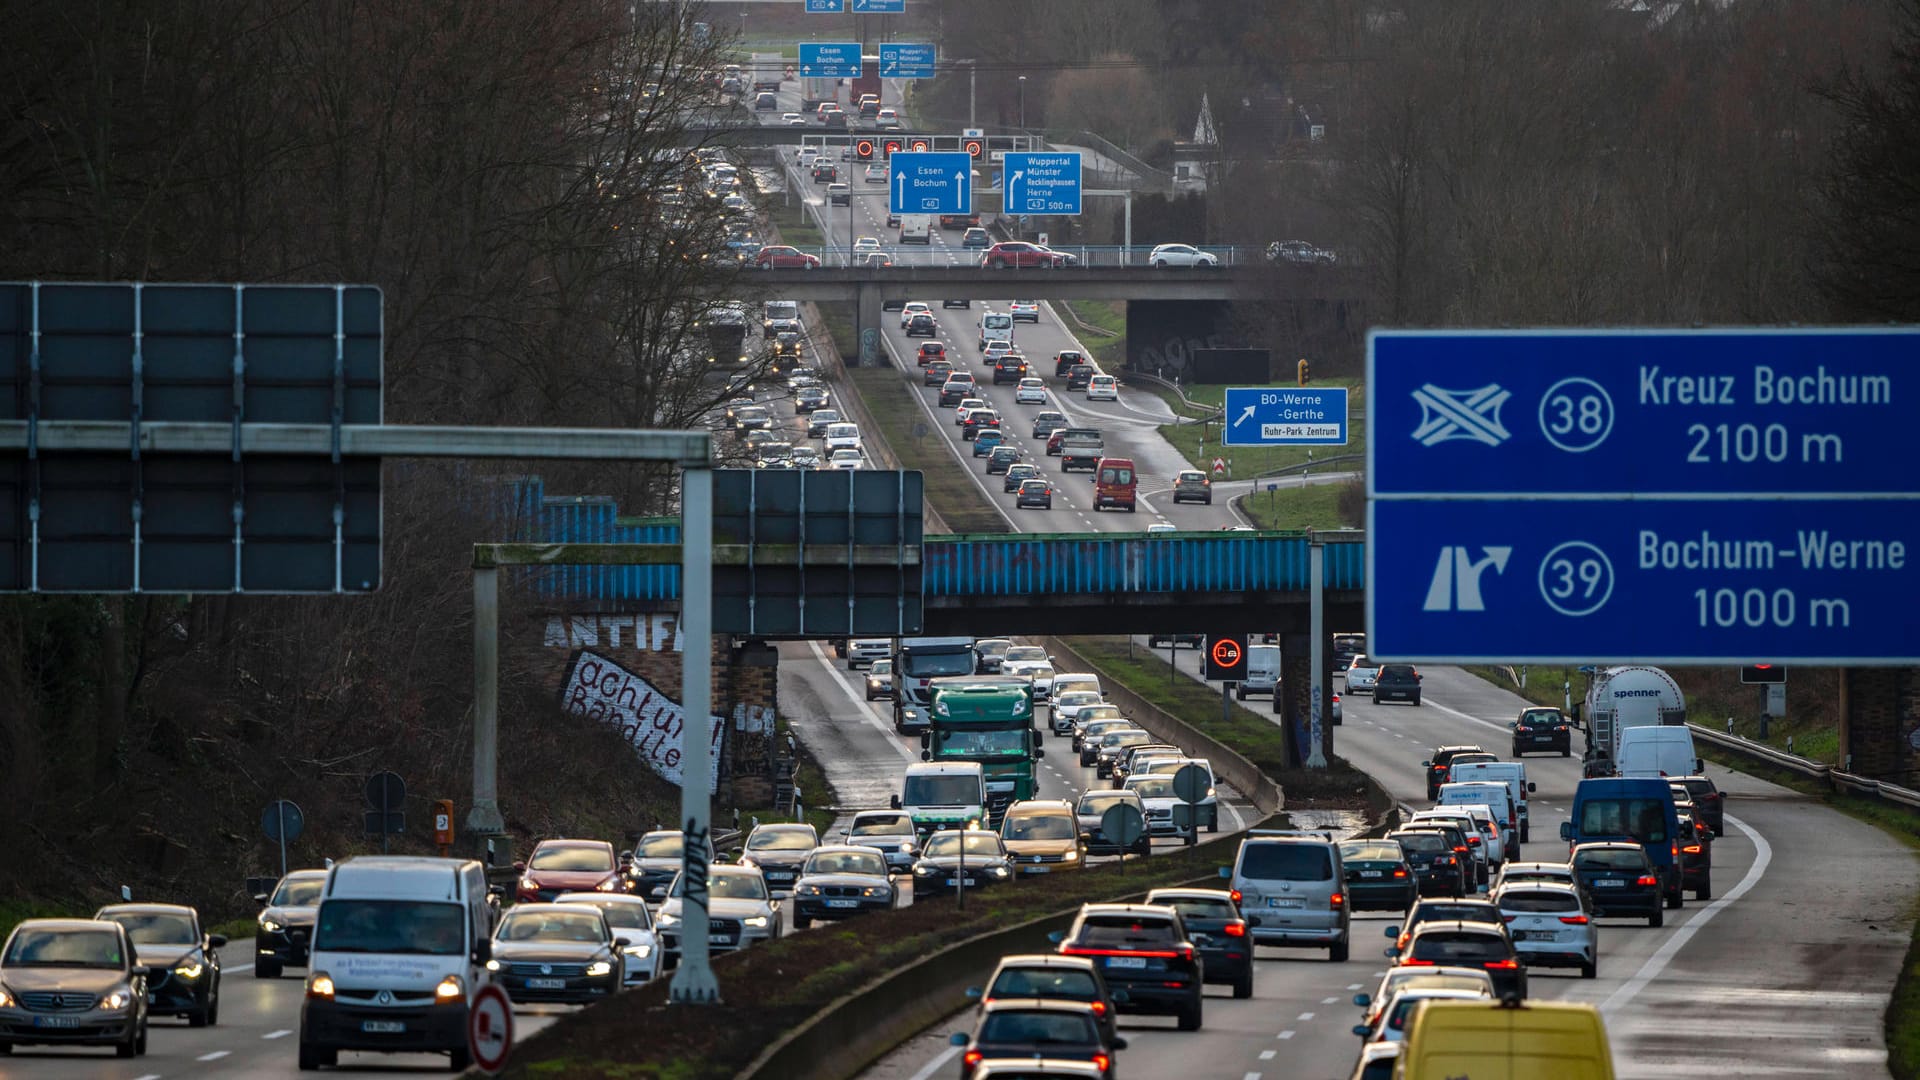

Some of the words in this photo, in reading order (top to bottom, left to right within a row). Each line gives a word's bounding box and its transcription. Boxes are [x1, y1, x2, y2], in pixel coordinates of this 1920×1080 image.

[820, 46, 841, 54] Essen
[816, 56, 845, 64] Bochum
[1027, 157, 1071, 167] Wuppertal
[918, 166, 944, 175] Essen
[1027, 168, 1062, 176] Münster
[914, 178, 947, 187] Bochum
[1027, 178, 1076, 187] Recklinghausen
[1027, 189, 1052, 197] Herne
[926, 200, 935, 208] 40
[1031, 200, 1042, 208] 43
[1048, 202, 1062, 210] 500
[1639, 366, 1735, 405] Kreuz
[1754, 366, 1891, 405] Bochum
[1261, 394, 1322, 405] BO-Werne
[1278, 408, 1324, 420] -Gerthe
[1551, 395, 1602, 435] 38
[1264, 426, 1303, 436] Ruhr-Park
[1306, 426, 1337, 436] Zentrum
[1687, 423, 1788, 463] 2100
[1802, 433, 1842, 463] m
[1639, 530, 1906, 571] Bochum-Werne
[1551, 558, 1602, 599] 39
[1694, 588, 1796, 628] 1000
[1809, 597, 1850, 628] m
[1614, 690, 1661, 699] spenner
